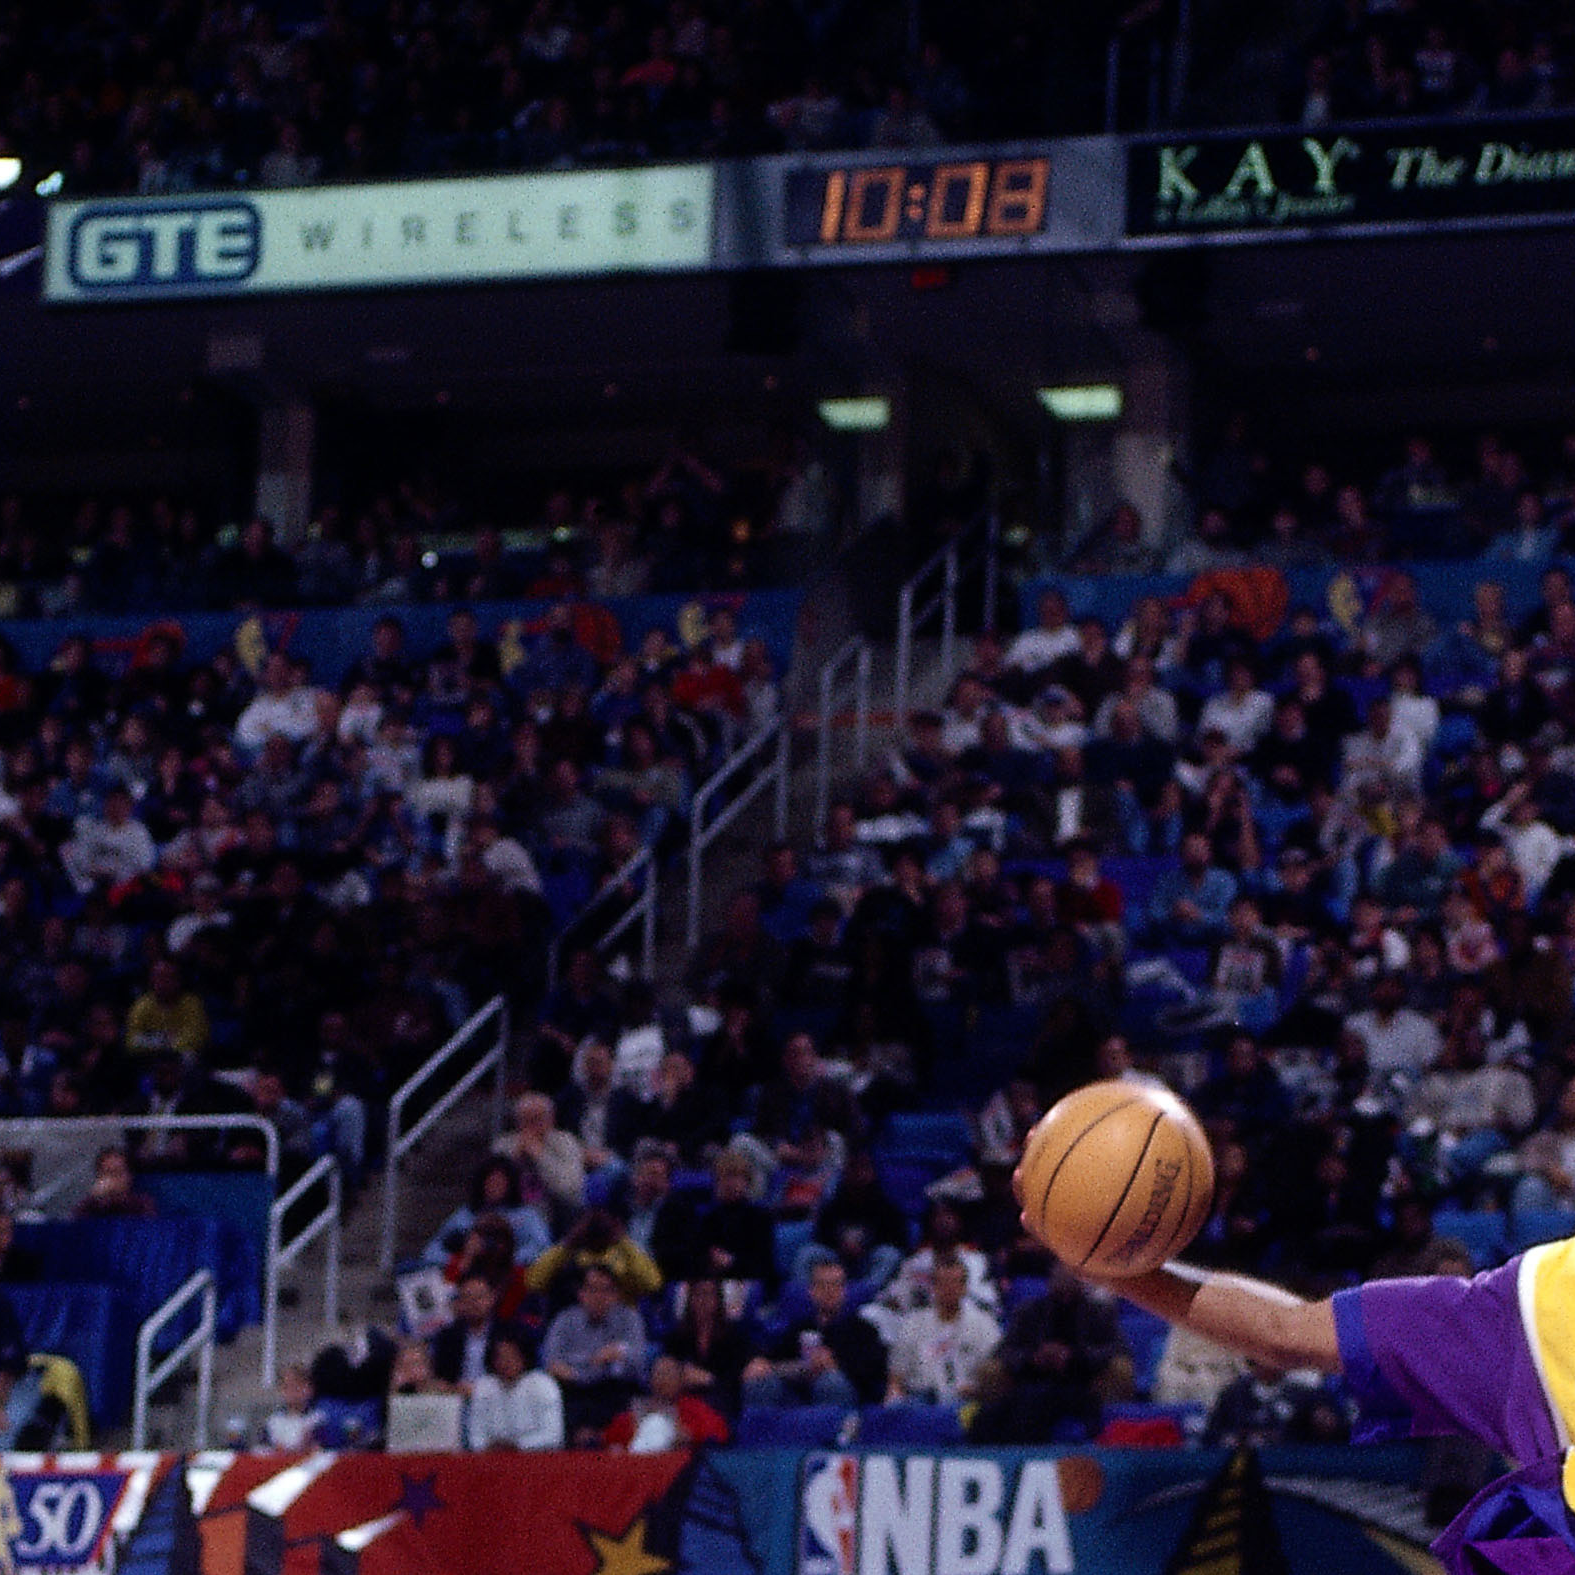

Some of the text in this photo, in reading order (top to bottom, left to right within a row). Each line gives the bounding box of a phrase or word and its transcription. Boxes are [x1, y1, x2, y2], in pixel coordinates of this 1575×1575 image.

[819, 158, 1051, 244] 10:08
[1155, 137, 1361, 203] KAY
[1388, 144, 1465, 190] The
[75, 197, 698, 280] GTE WIRELESS
[15, 1480, 104, 1558] 50
